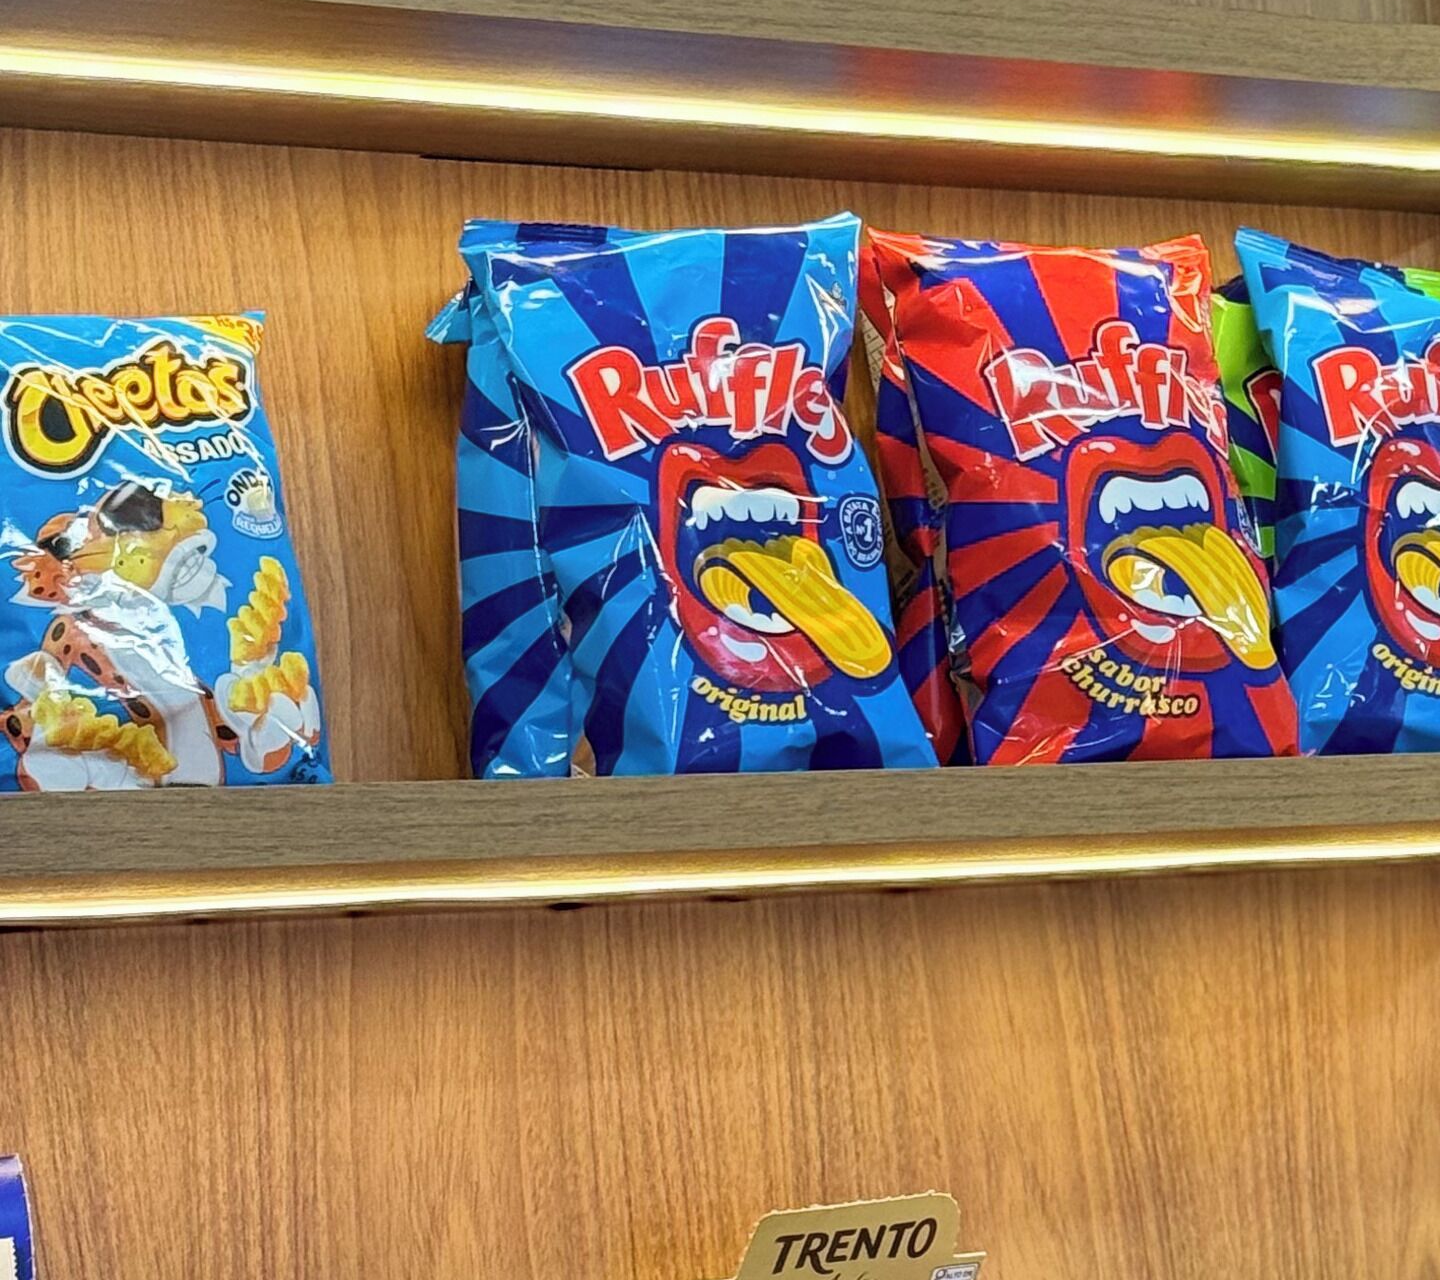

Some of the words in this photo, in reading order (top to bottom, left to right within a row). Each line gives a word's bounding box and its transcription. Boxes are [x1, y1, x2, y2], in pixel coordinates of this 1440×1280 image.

[10, 340, 252, 469] Cheetos
[570, 319, 851, 462] Ruffles
[142, 429, 246, 464] ASSADO
[1062, 655, 1199, 716] churrasco
[1088, 647, 1167, 693] sabor
[772, 1217, 937, 1274] TRENTO
